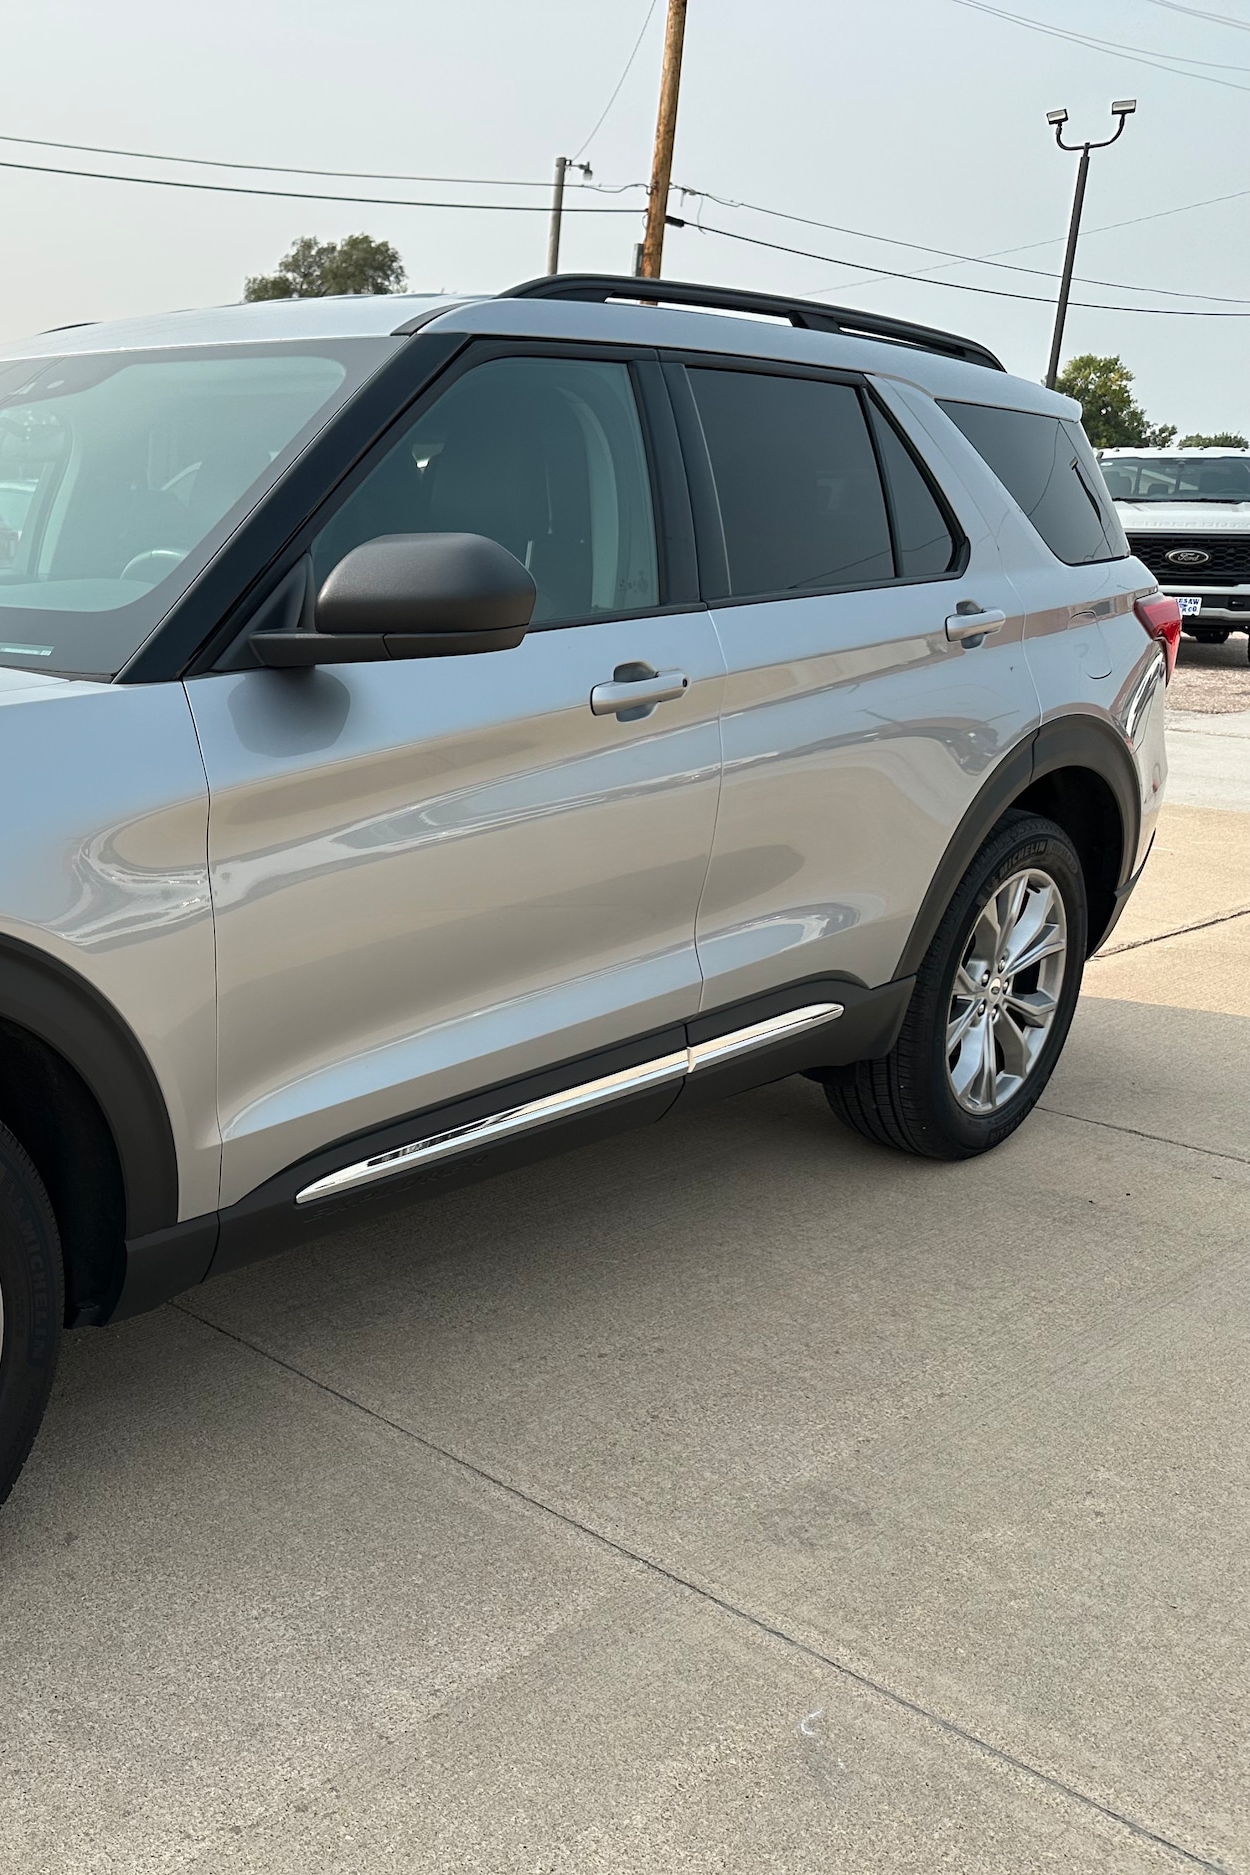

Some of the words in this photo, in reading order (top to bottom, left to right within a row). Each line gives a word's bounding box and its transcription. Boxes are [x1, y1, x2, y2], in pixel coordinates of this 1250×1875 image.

[1177, 552, 1200, 561] Ford
[1000, 840, 1047, 878] MICHELIN
[20, 1218, 48, 1361] MICHELIN
